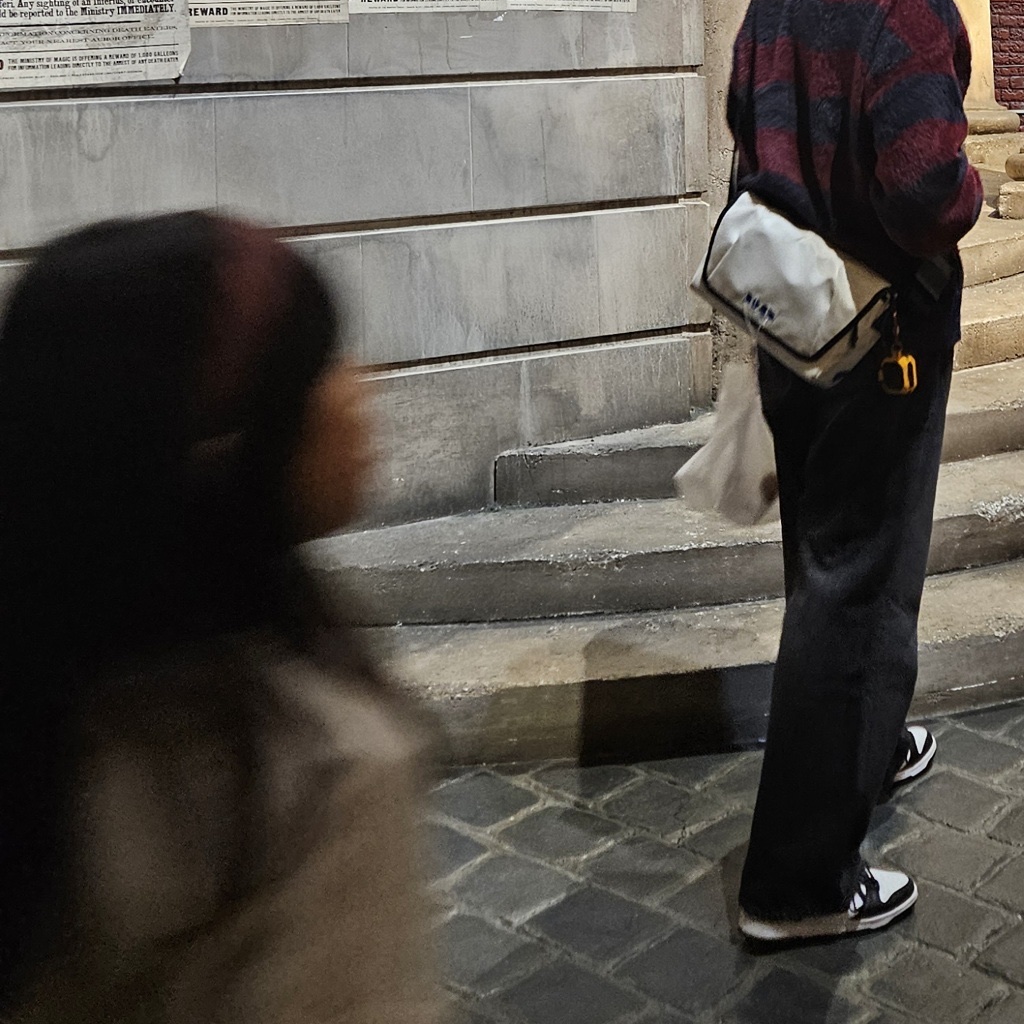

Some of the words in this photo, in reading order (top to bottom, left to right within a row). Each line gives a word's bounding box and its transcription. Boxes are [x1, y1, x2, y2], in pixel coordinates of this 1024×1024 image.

[9, 9, 17, 17] be
[20, 8, 53, 19] reported
[66, 8, 78, 16] the
[80, 6, 115, 17] Ministry
[189, 7, 228, 16] REWARD
